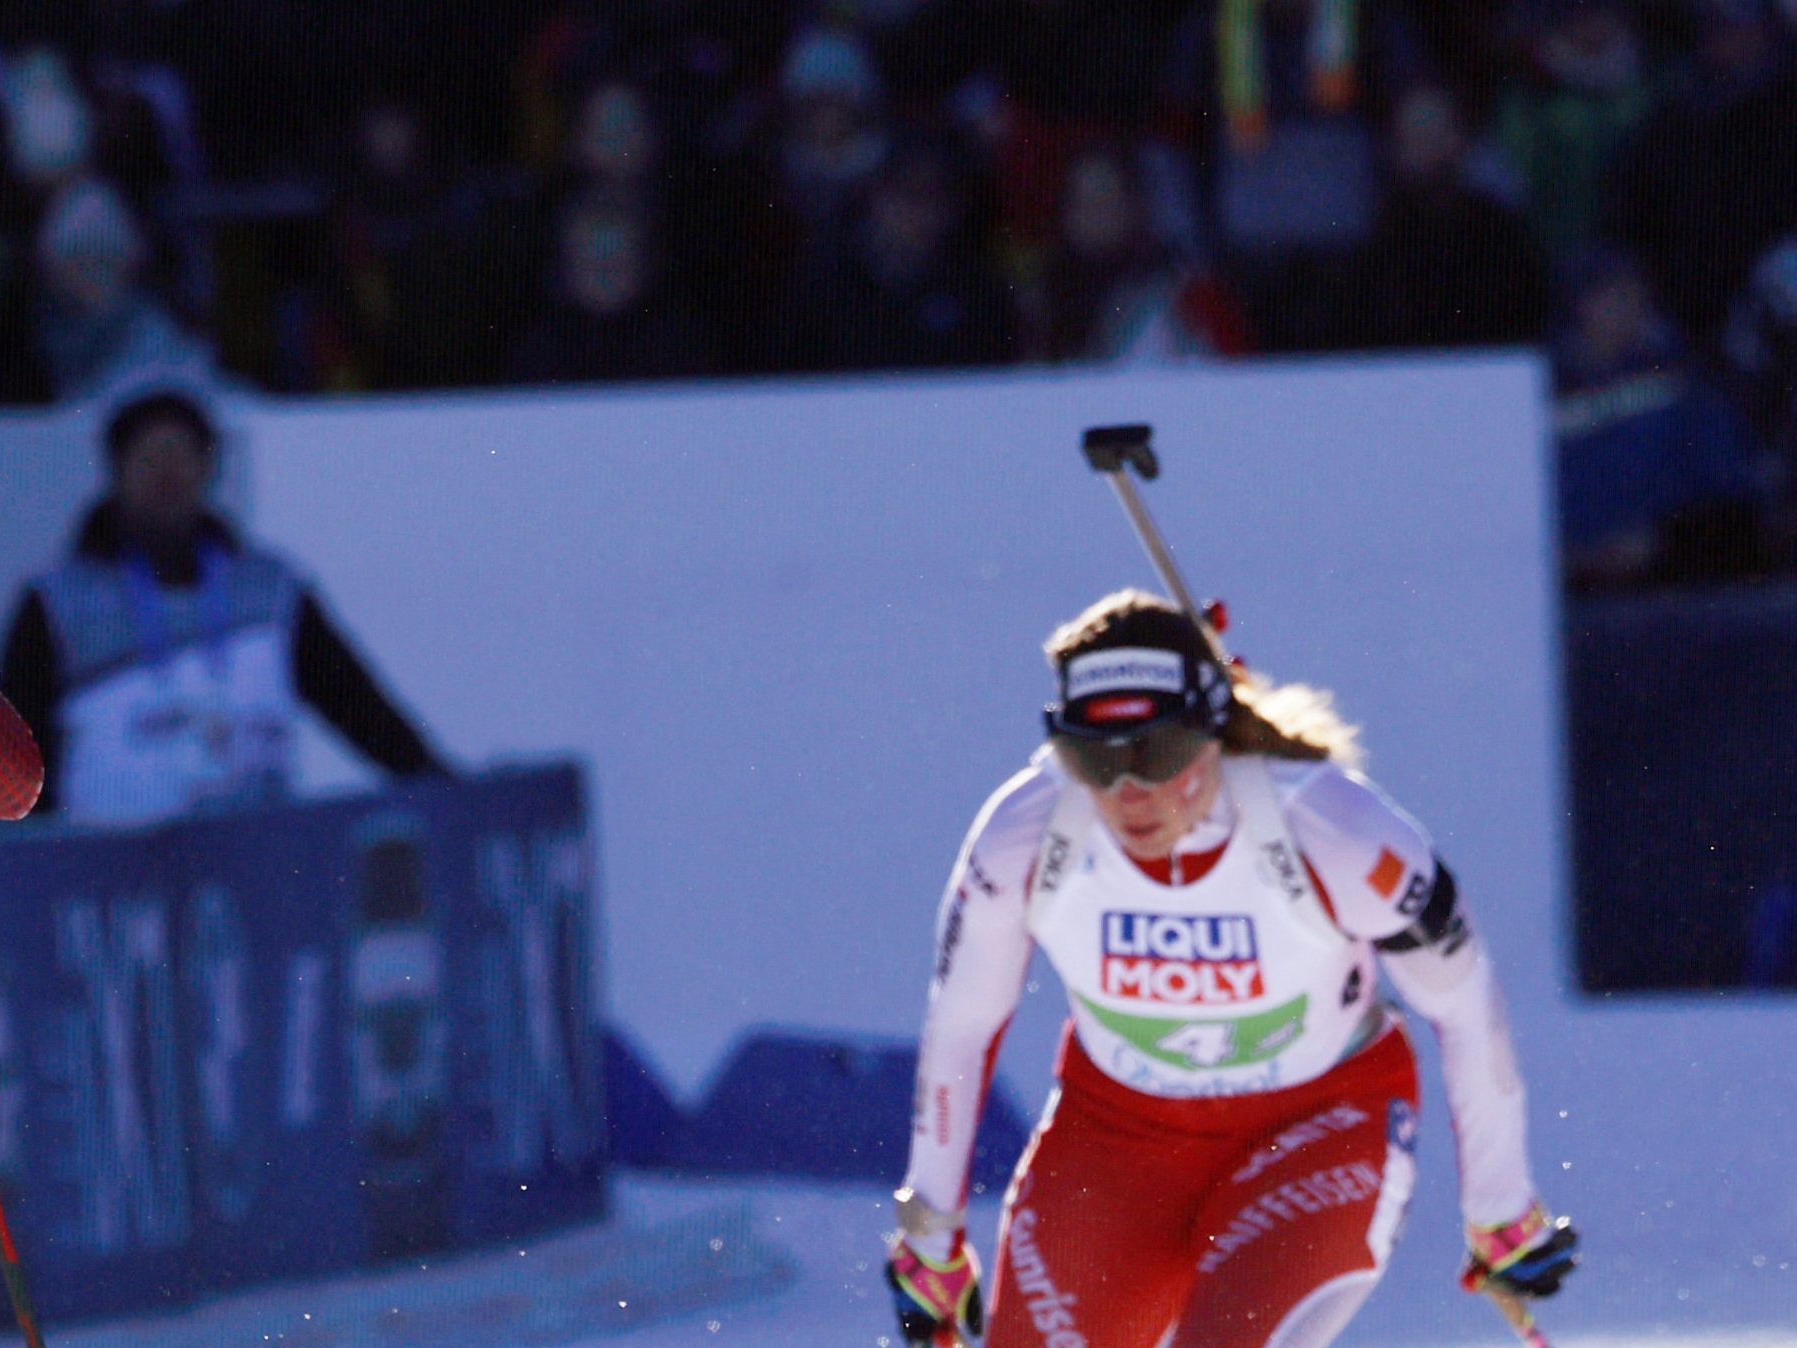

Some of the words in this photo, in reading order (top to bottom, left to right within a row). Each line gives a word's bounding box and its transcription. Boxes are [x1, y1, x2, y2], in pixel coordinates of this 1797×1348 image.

[1108, 915, 1255, 961] LIQUI
[1106, 960, 1256, 1002] MOLY
[1156, 1021, 1235, 1067] 4
